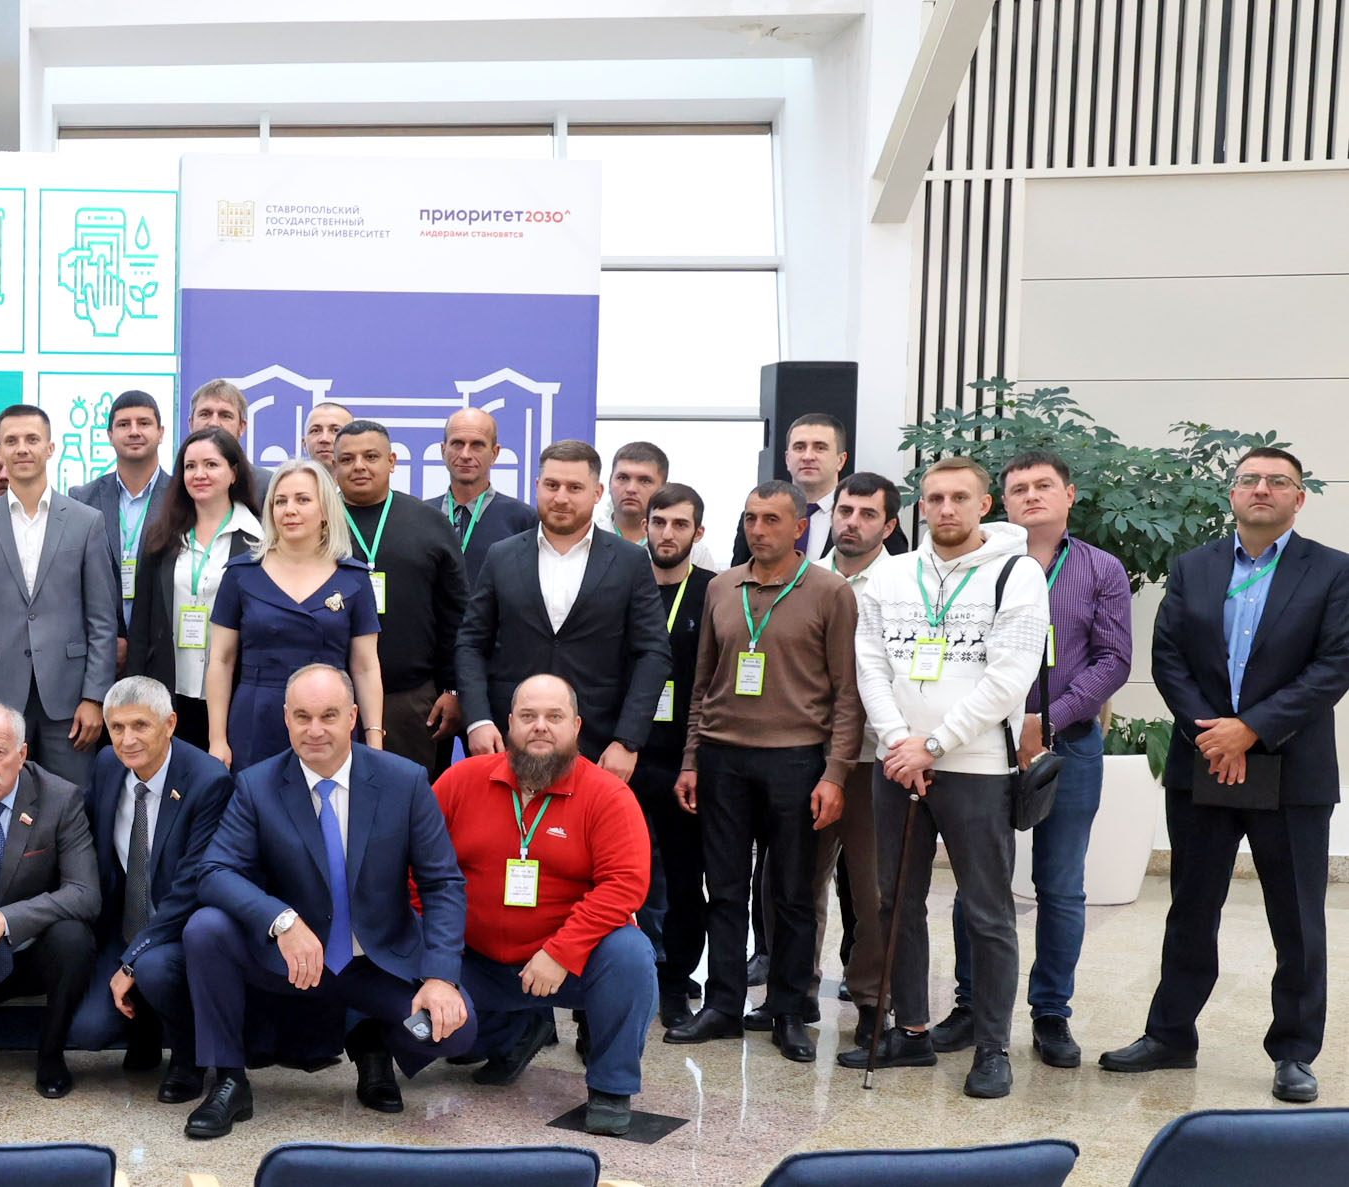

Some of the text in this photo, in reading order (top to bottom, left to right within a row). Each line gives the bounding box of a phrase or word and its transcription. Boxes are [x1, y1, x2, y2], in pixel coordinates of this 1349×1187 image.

[265, 204, 360, 214] СТАВРОПОЛЬСКИЙ
[265, 216, 364, 226] ГОСУДАРСТВЕННЫЙ
[265, 227, 391, 238] АГРАРНЫЙ УНИВЕРСИТЕТ
[419, 230, 524, 239] лидерами становятся
